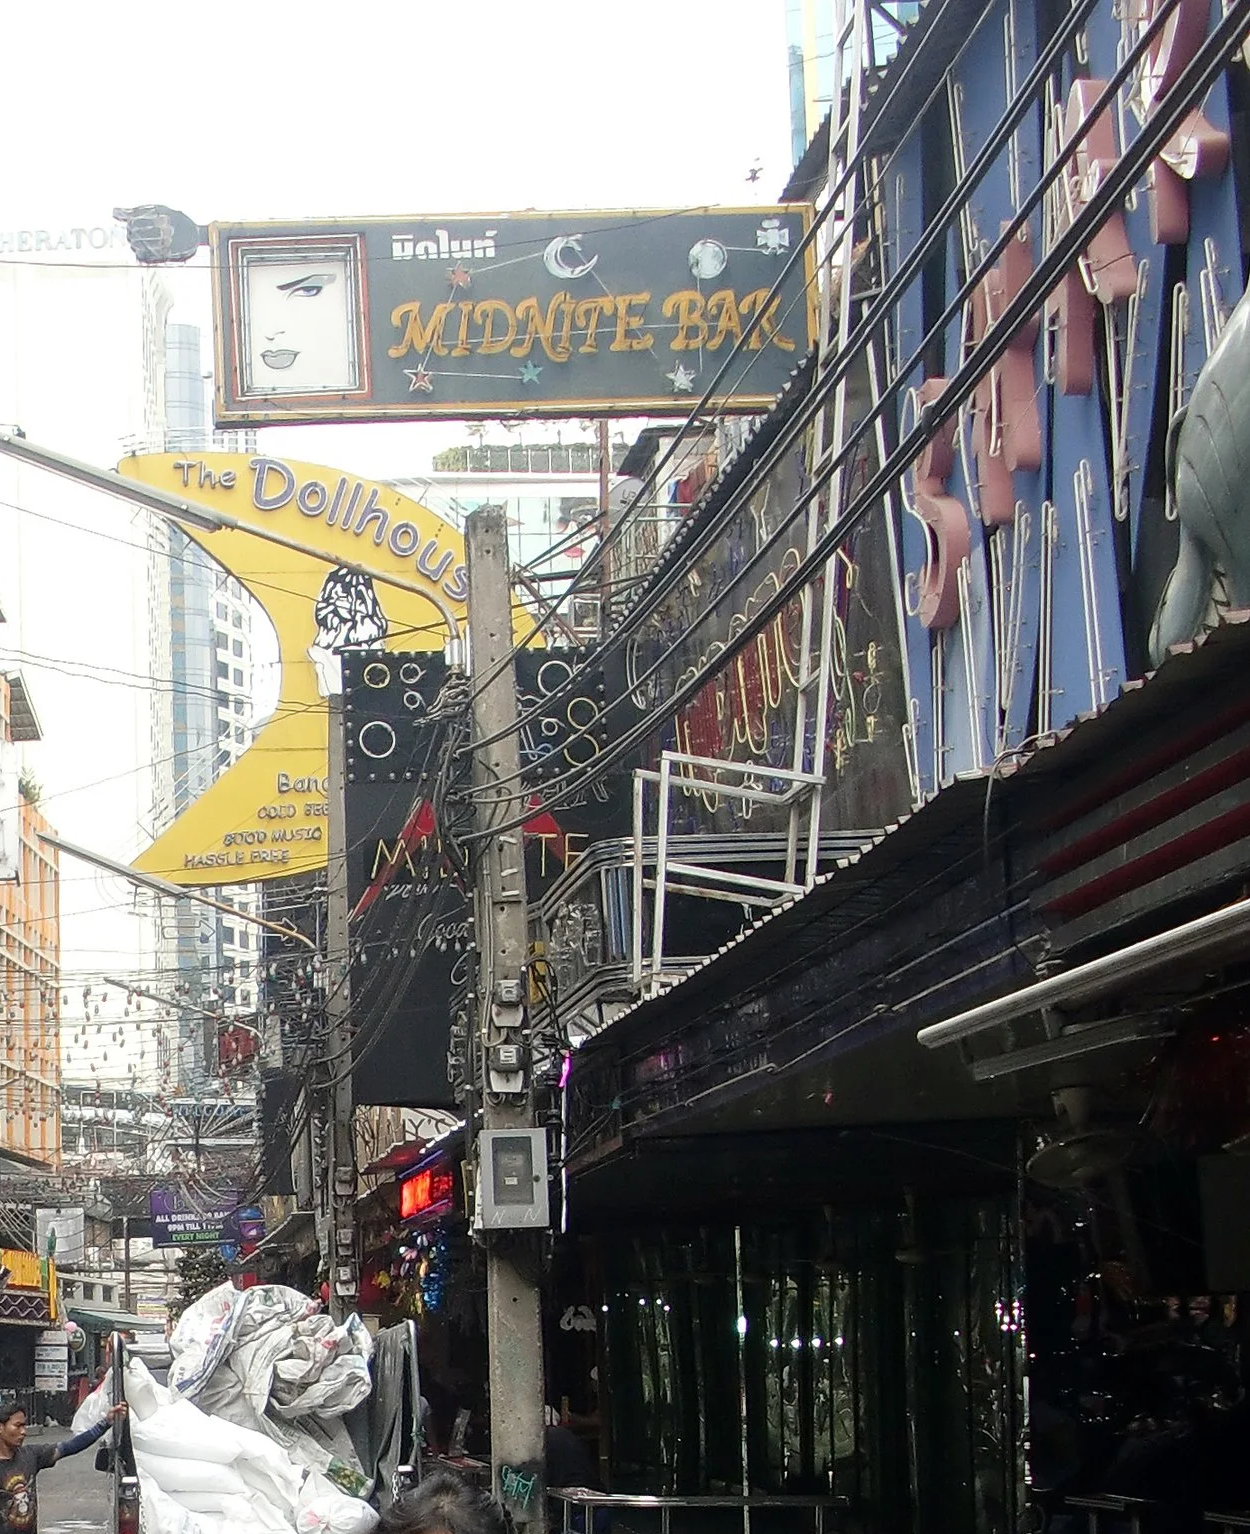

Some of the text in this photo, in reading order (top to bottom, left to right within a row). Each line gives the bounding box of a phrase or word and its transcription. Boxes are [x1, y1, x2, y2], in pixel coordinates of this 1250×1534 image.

[388, 288, 796, 363] MIDNITE BAR
[173, 459, 237, 489] The
[271, 826, 322, 843] MUSIC
[184, 849, 290, 867] HASSLE FREE
[156, 1214, 170, 1223] ALL
[186, 1222, 201, 1231] TILL
[171, 1231, 220, 1241] EVERY NIGHT
